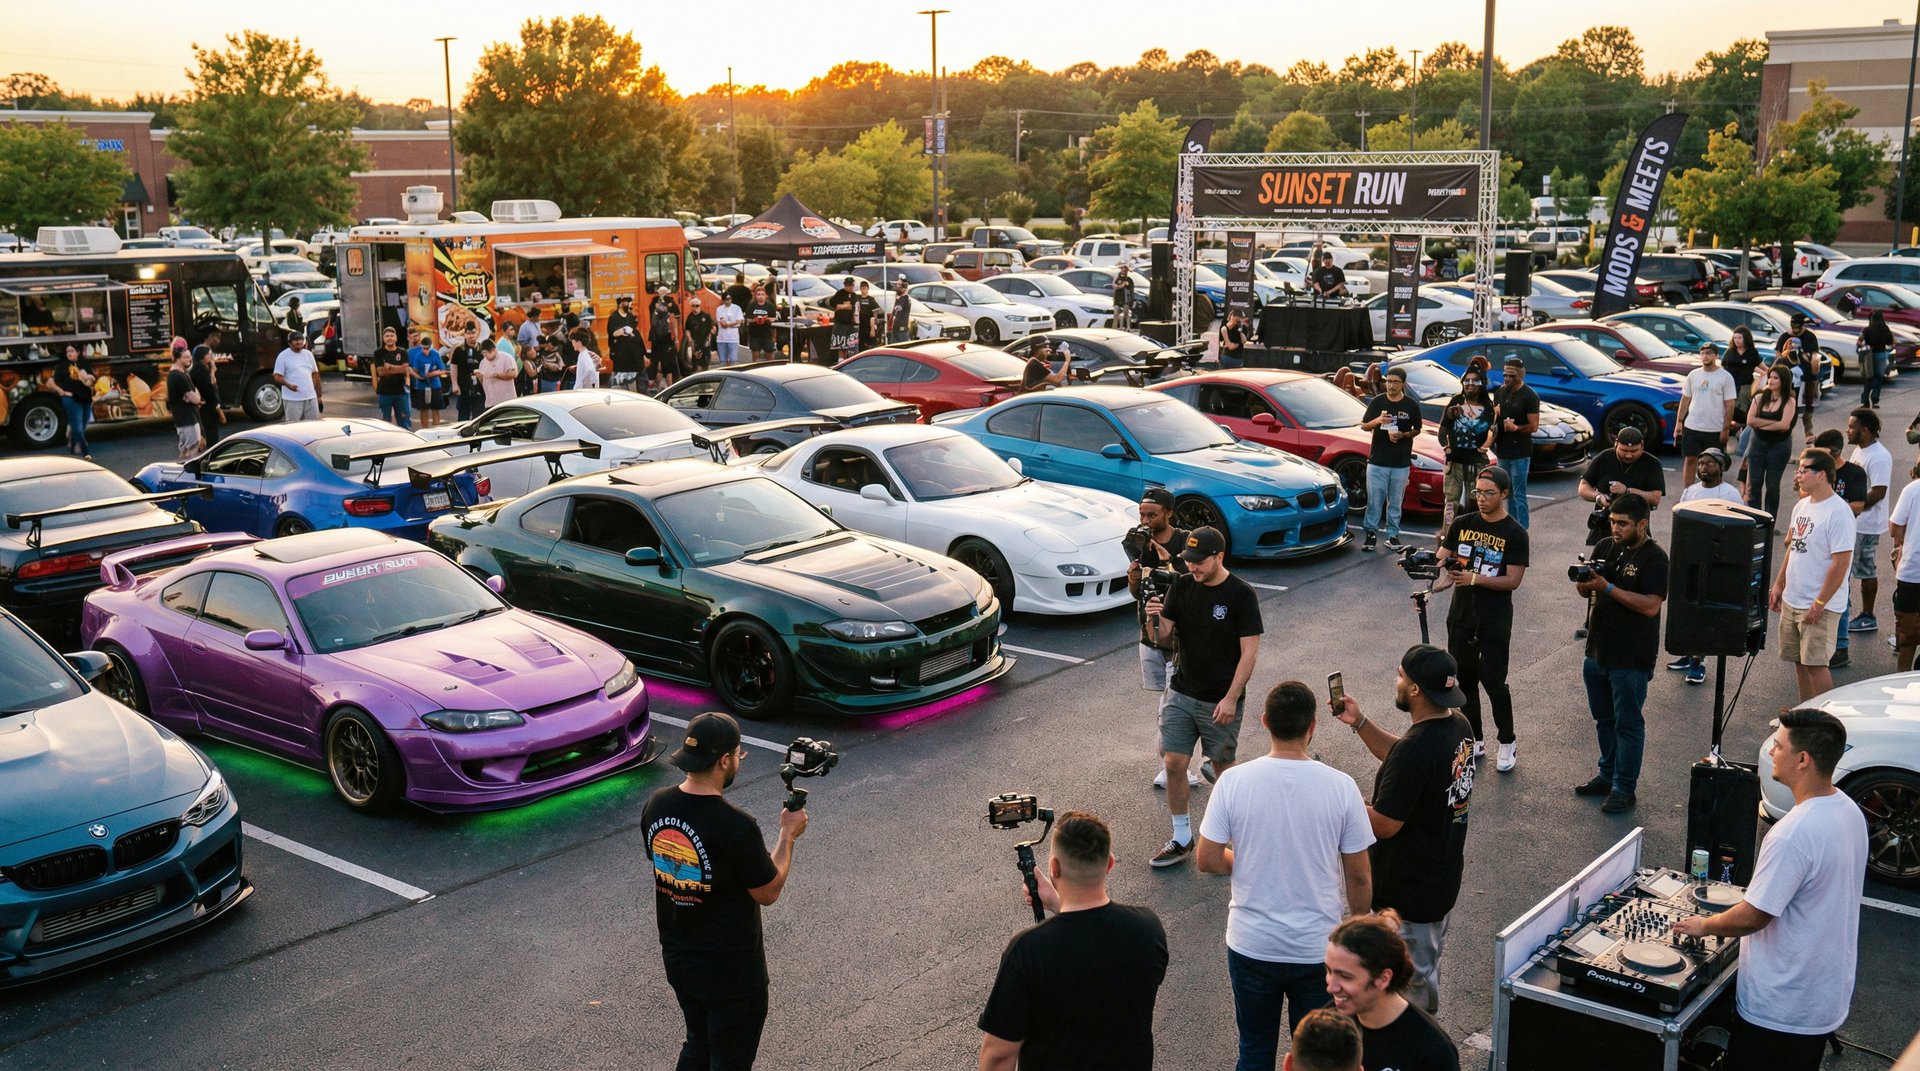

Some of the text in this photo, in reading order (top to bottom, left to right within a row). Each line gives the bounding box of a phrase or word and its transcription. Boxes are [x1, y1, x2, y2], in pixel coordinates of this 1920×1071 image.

[1258, 171, 1407, 205] SUNSET RUN
[1603, 136, 1670, 298] MODS & MEETS
[1586, 969, 1632, 988] Pioneer
